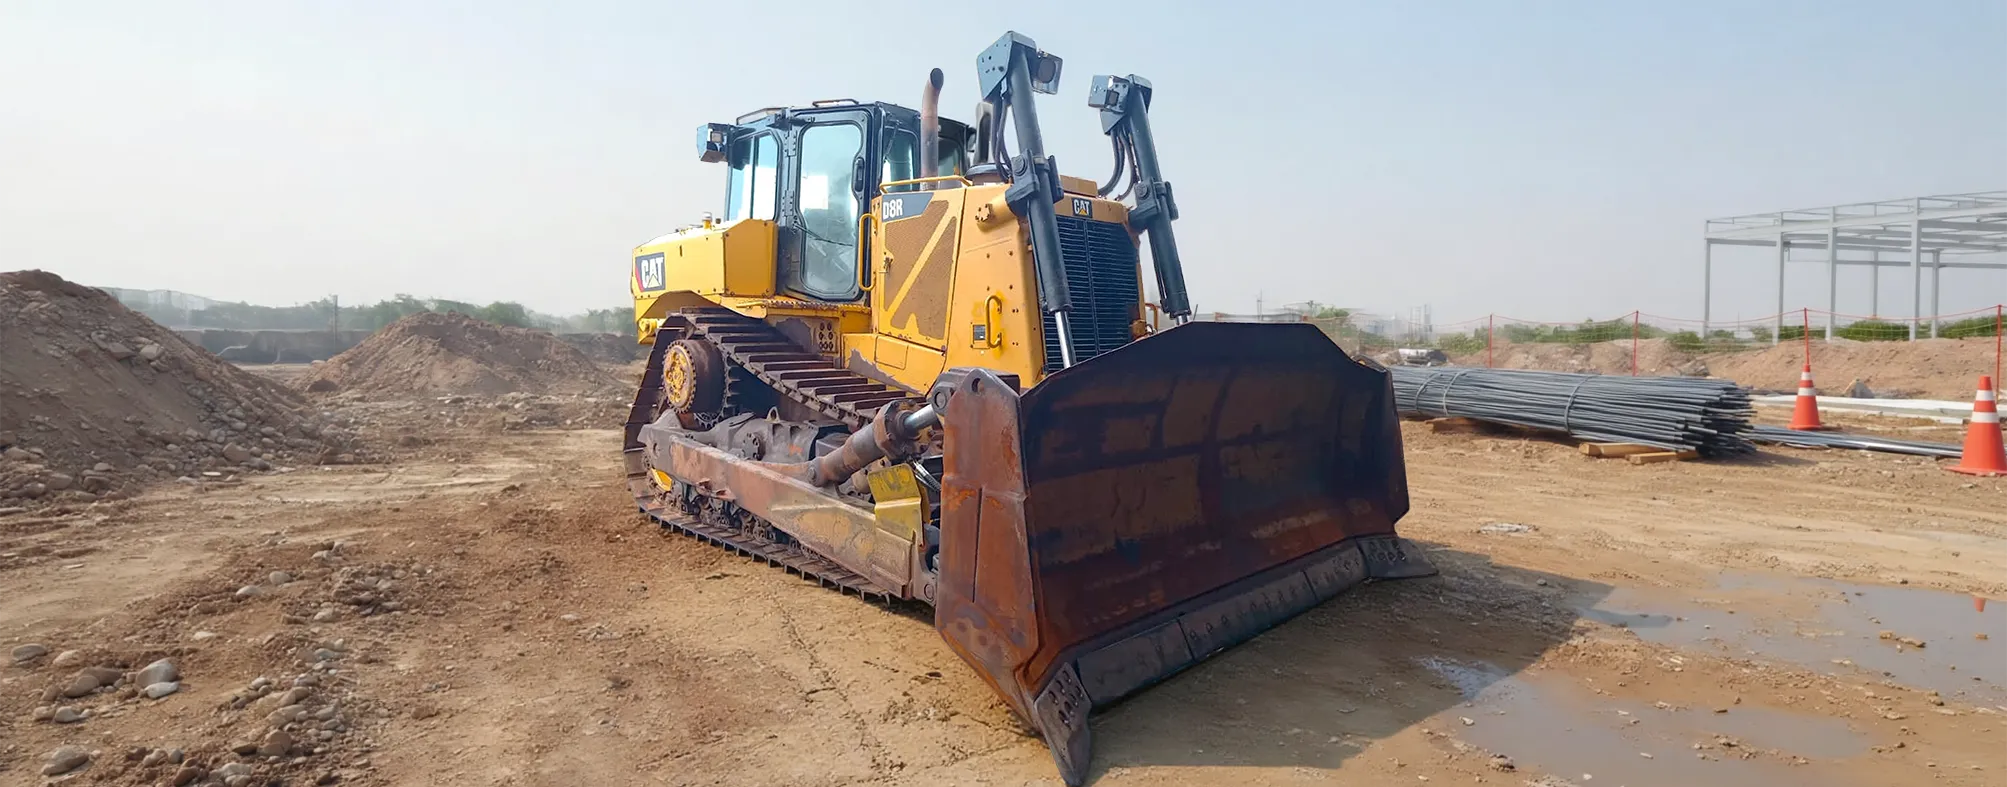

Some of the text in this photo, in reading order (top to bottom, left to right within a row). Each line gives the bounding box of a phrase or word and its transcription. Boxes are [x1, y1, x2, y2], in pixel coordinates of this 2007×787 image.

[882, 198, 903, 220] D8R
[1074, 199, 1090, 216] CAT
[641, 256, 664, 289] CAT
